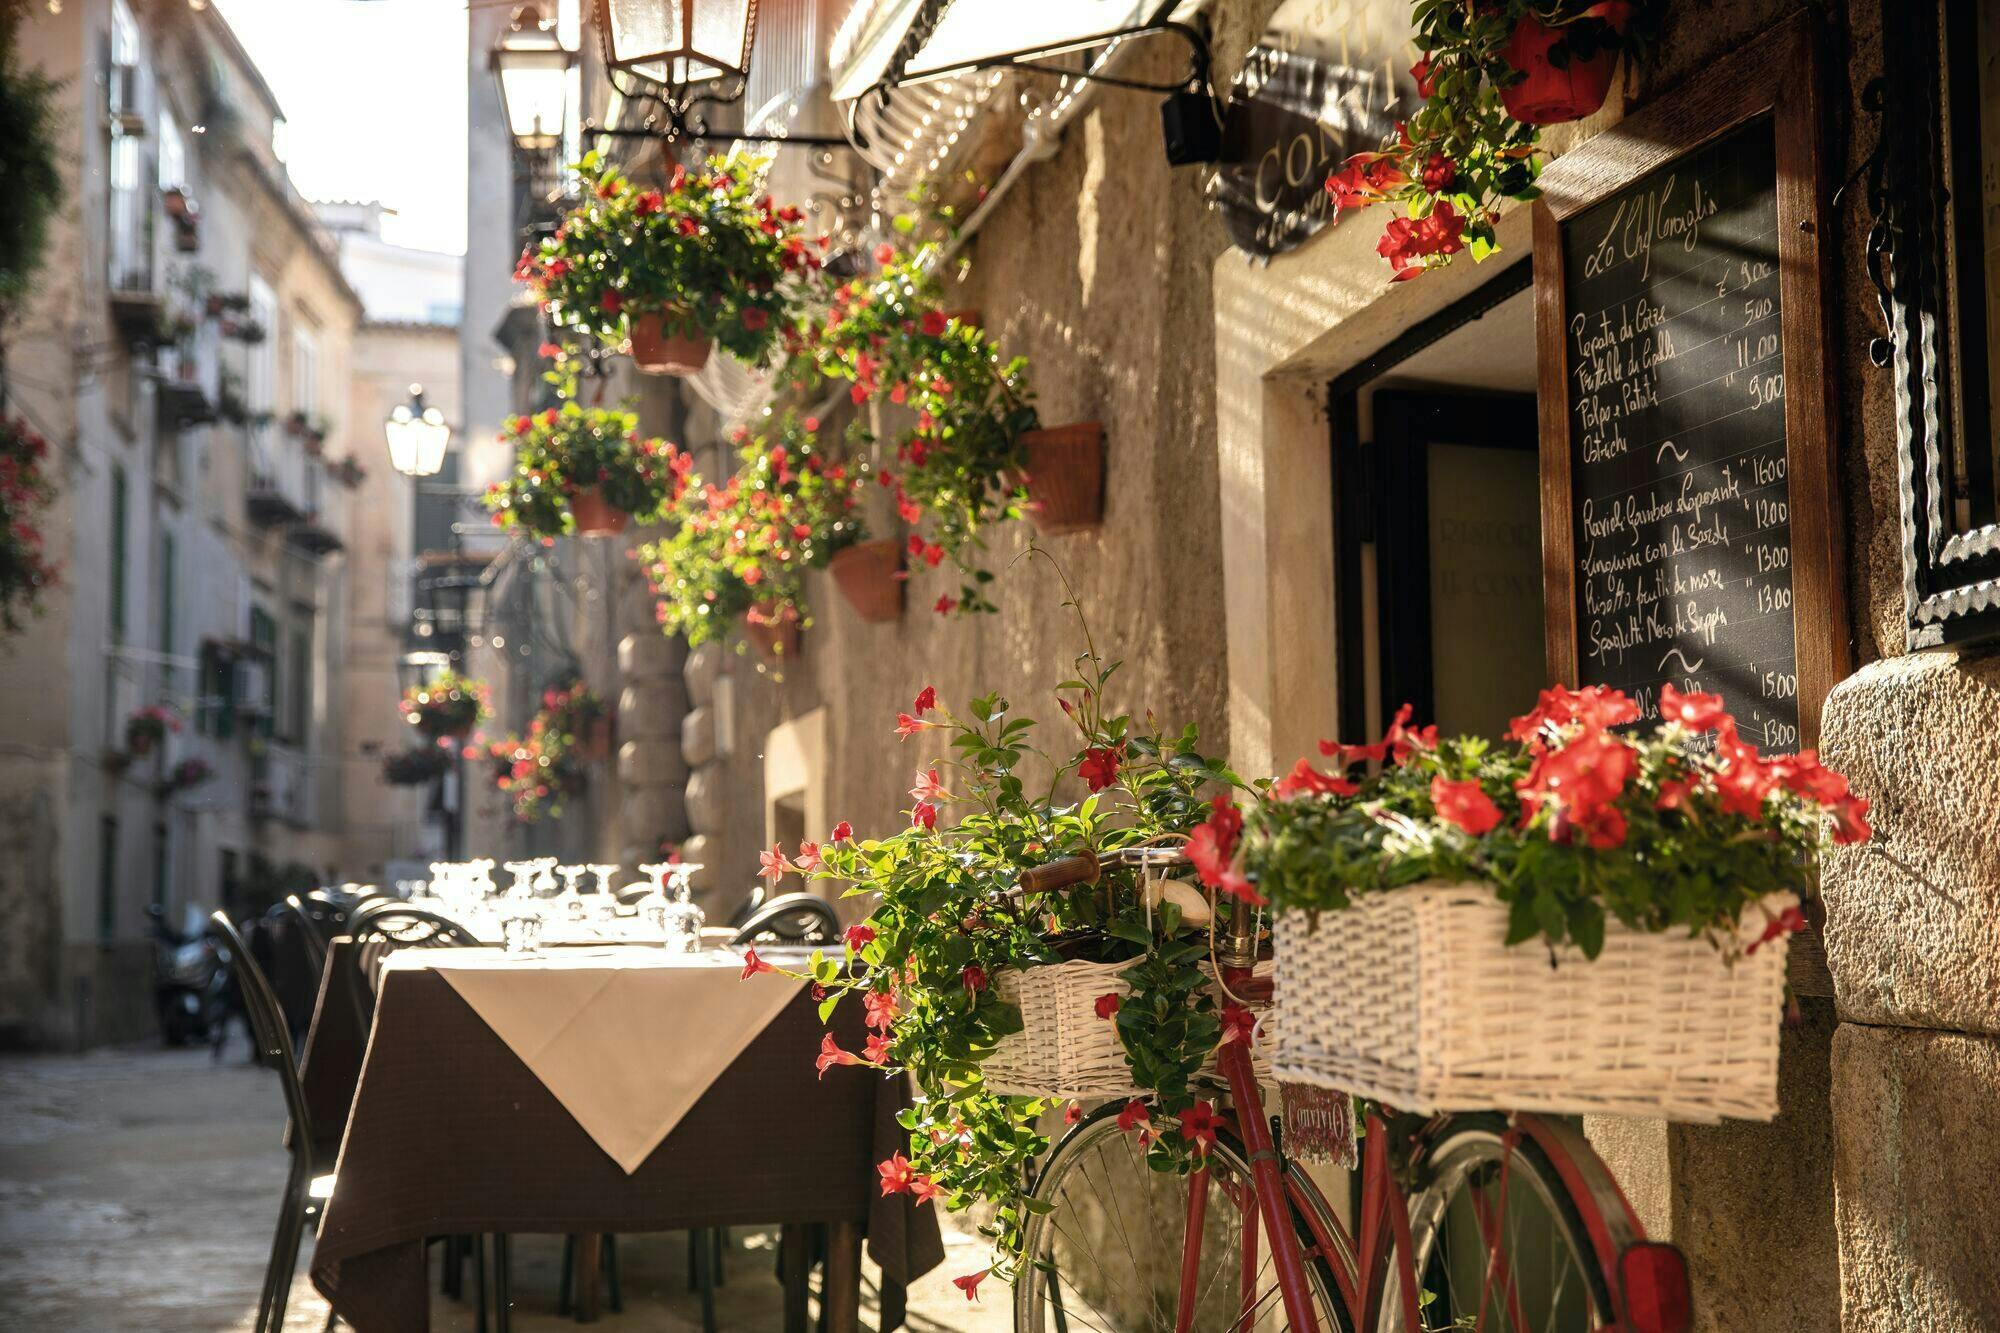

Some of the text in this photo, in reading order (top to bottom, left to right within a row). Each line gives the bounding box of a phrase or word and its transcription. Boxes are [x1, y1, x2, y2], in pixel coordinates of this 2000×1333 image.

[1624, 191, 1655, 282] Chef
[1620, 304, 1634, 342] di
[1628, 342, 1640, 376] di
[1738, 333, 1777, 367] 11.00
[1575, 395, 1611, 438] Polpo
[1614, 405, 1620, 417] e
[1645, 541, 1668, 563] con
[1674, 564, 1686, 595] di
[1675, 603, 1686, 638] di
